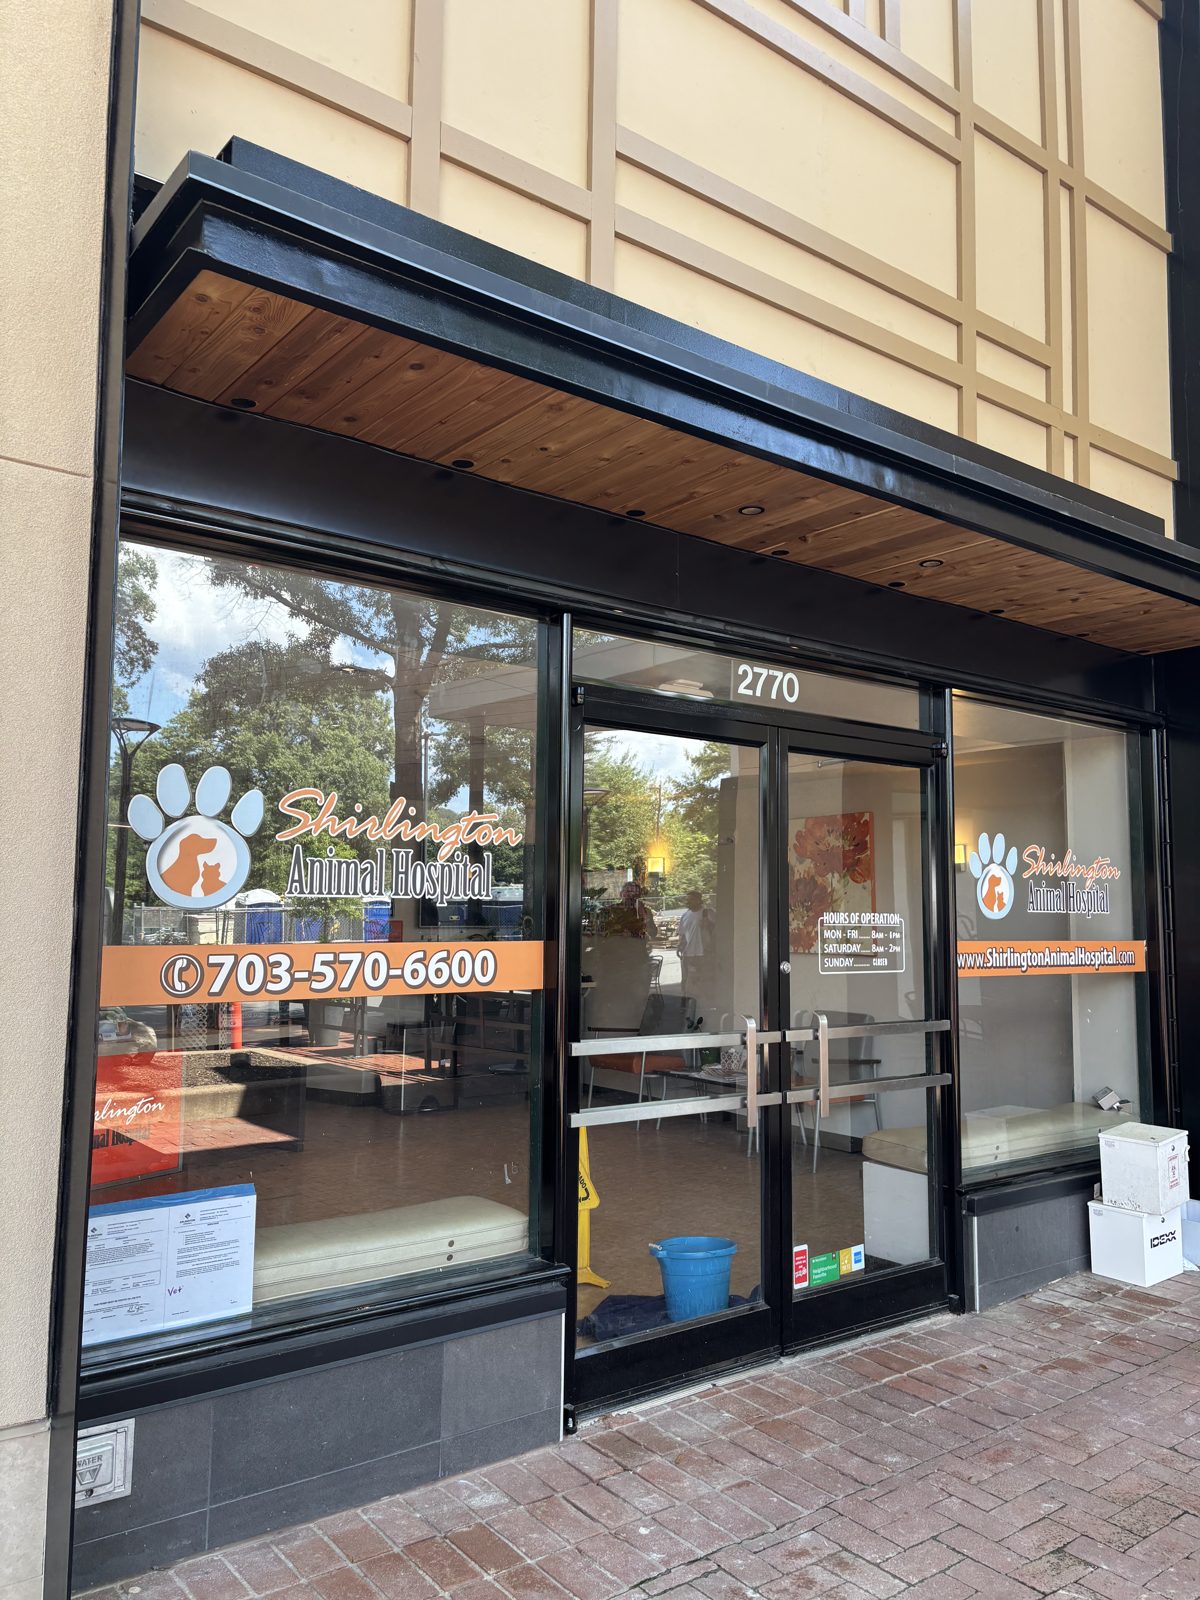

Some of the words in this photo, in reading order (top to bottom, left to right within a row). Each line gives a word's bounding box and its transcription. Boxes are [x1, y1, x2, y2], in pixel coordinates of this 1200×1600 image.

[737, 664, 799, 703] 2770
[276, 787, 523, 861] Shirlington
[286, 844, 385, 899] Animal
[391, 848, 493, 907] Hospital
[1022, 844, 1121, 888] Shirlington
[823, 912, 848, 924] HOURS
[850, 912, 859, 924] OF
[861, 913, 900, 924] OPERATION
[1028, 880, 1066, 913] Animal
[1067, 882, 1110, 918] Hospital
[823, 930, 842, 939] MON
[207, 949, 498, 996] 703-570-6600
[957, 947, 1135, 972] www.ShirlingtonAnimalHospital.com
[1150, 1230, 1177, 1249] IDEXX
[167, 1286, 183, 1296] Vet
